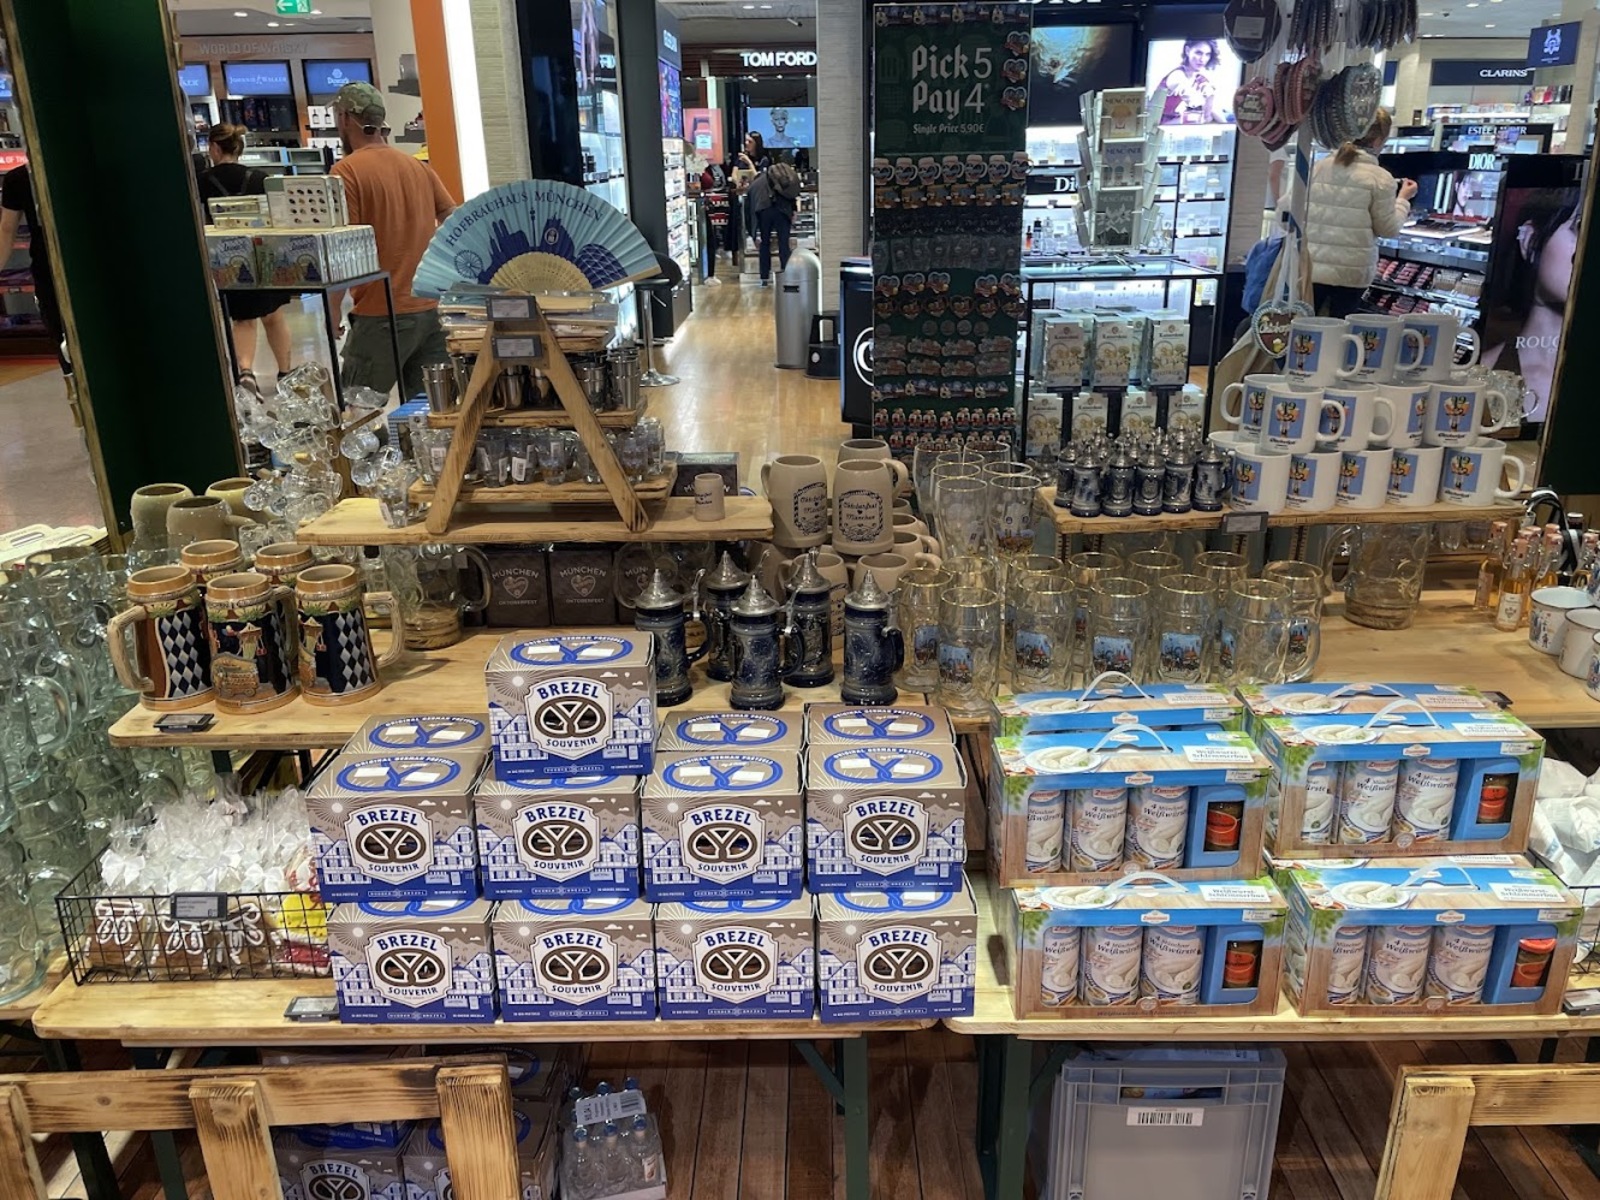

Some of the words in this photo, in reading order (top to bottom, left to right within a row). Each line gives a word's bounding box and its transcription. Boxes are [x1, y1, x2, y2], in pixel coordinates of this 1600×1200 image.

[739, 52, 775, 67] TOM
[776, 51, 817, 66] FORD
[912, 43, 970, 80] Pick
[973, 47, 993, 79] 5
[1479, 69, 1528, 78] CLARINS
[912, 79, 960, 120] Pay
[912, 123, 937, 135] Single
[938, 123, 959, 134] Price
[1468, 153, 1496, 170] DIOR
[535, 189, 604, 222] MÜNCHEN
[491, 567, 539, 580] MÜNCHEN
[559, 565, 607, 578] MÜNCHEN
[537, 681, 599, 700] BREZEL
[546, 735, 598, 749] SOUVENIR
[356, 808, 419, 827] BREZEL
[524, 807, 586, 827] BREZEL
[690, 808, 752, 826] BREZEL
[856, 801, 916, 818] BREZEL
[533, 859, 585, 872] SOUVENIR
[860, 853, 912, 865] SOUVENIR
[367, 861, 420, 875] SOUVENIR
[697, 861, 749, 874] SOUVENIR
[377, 934, 438, 952] BREZEL
[542, 932, 603, 950] BREZEL
[704, 930, 765, 948] BREZEL
[868, 928, 929, 947] BREZEL
[387, 985, 439, 996] SOUVENIR
[551, 983, 602, 995] SOUVENIR
[710, 982, 761, 993] SOUVENIR
[873, 981, 923, 993] SOUVENIR
[308, 1163, 360, 1179] BREZEL
